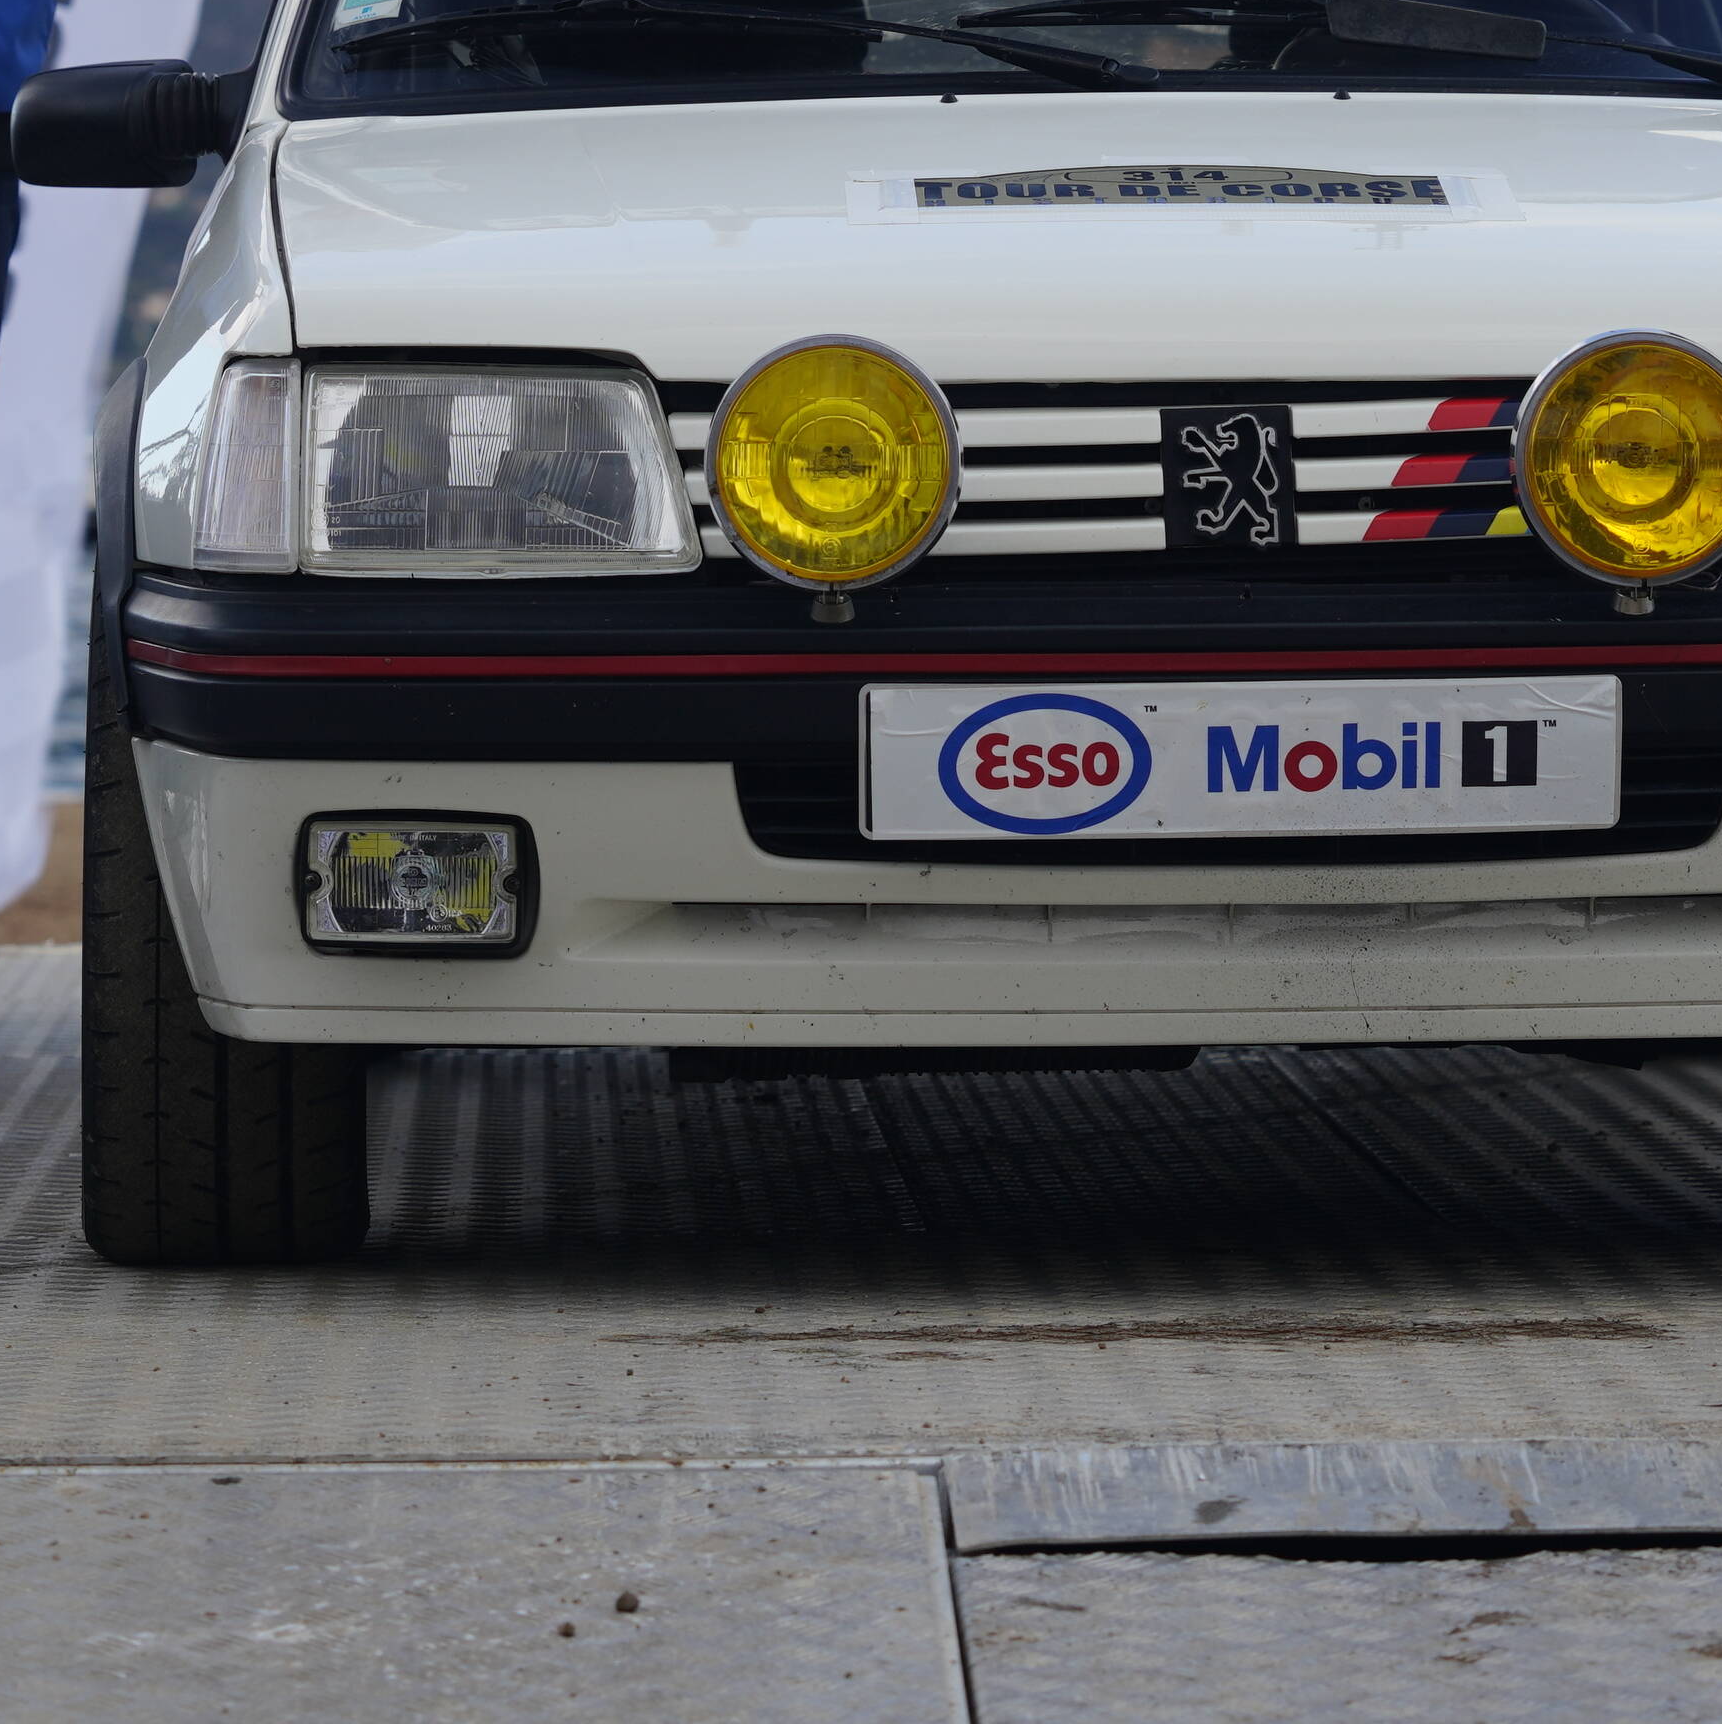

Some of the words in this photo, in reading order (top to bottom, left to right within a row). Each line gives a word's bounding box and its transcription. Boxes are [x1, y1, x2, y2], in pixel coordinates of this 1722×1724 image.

[915, 181, 1094, 199] TOUR
[1118, 184, 1201, 197] DE
[1221, 180, 1447, 198] CORSE
[1123, 170, 1228, 181] 314
[975, 733, 1120, 790] Esso
[1207, 722, 1441, 793] Mobil
